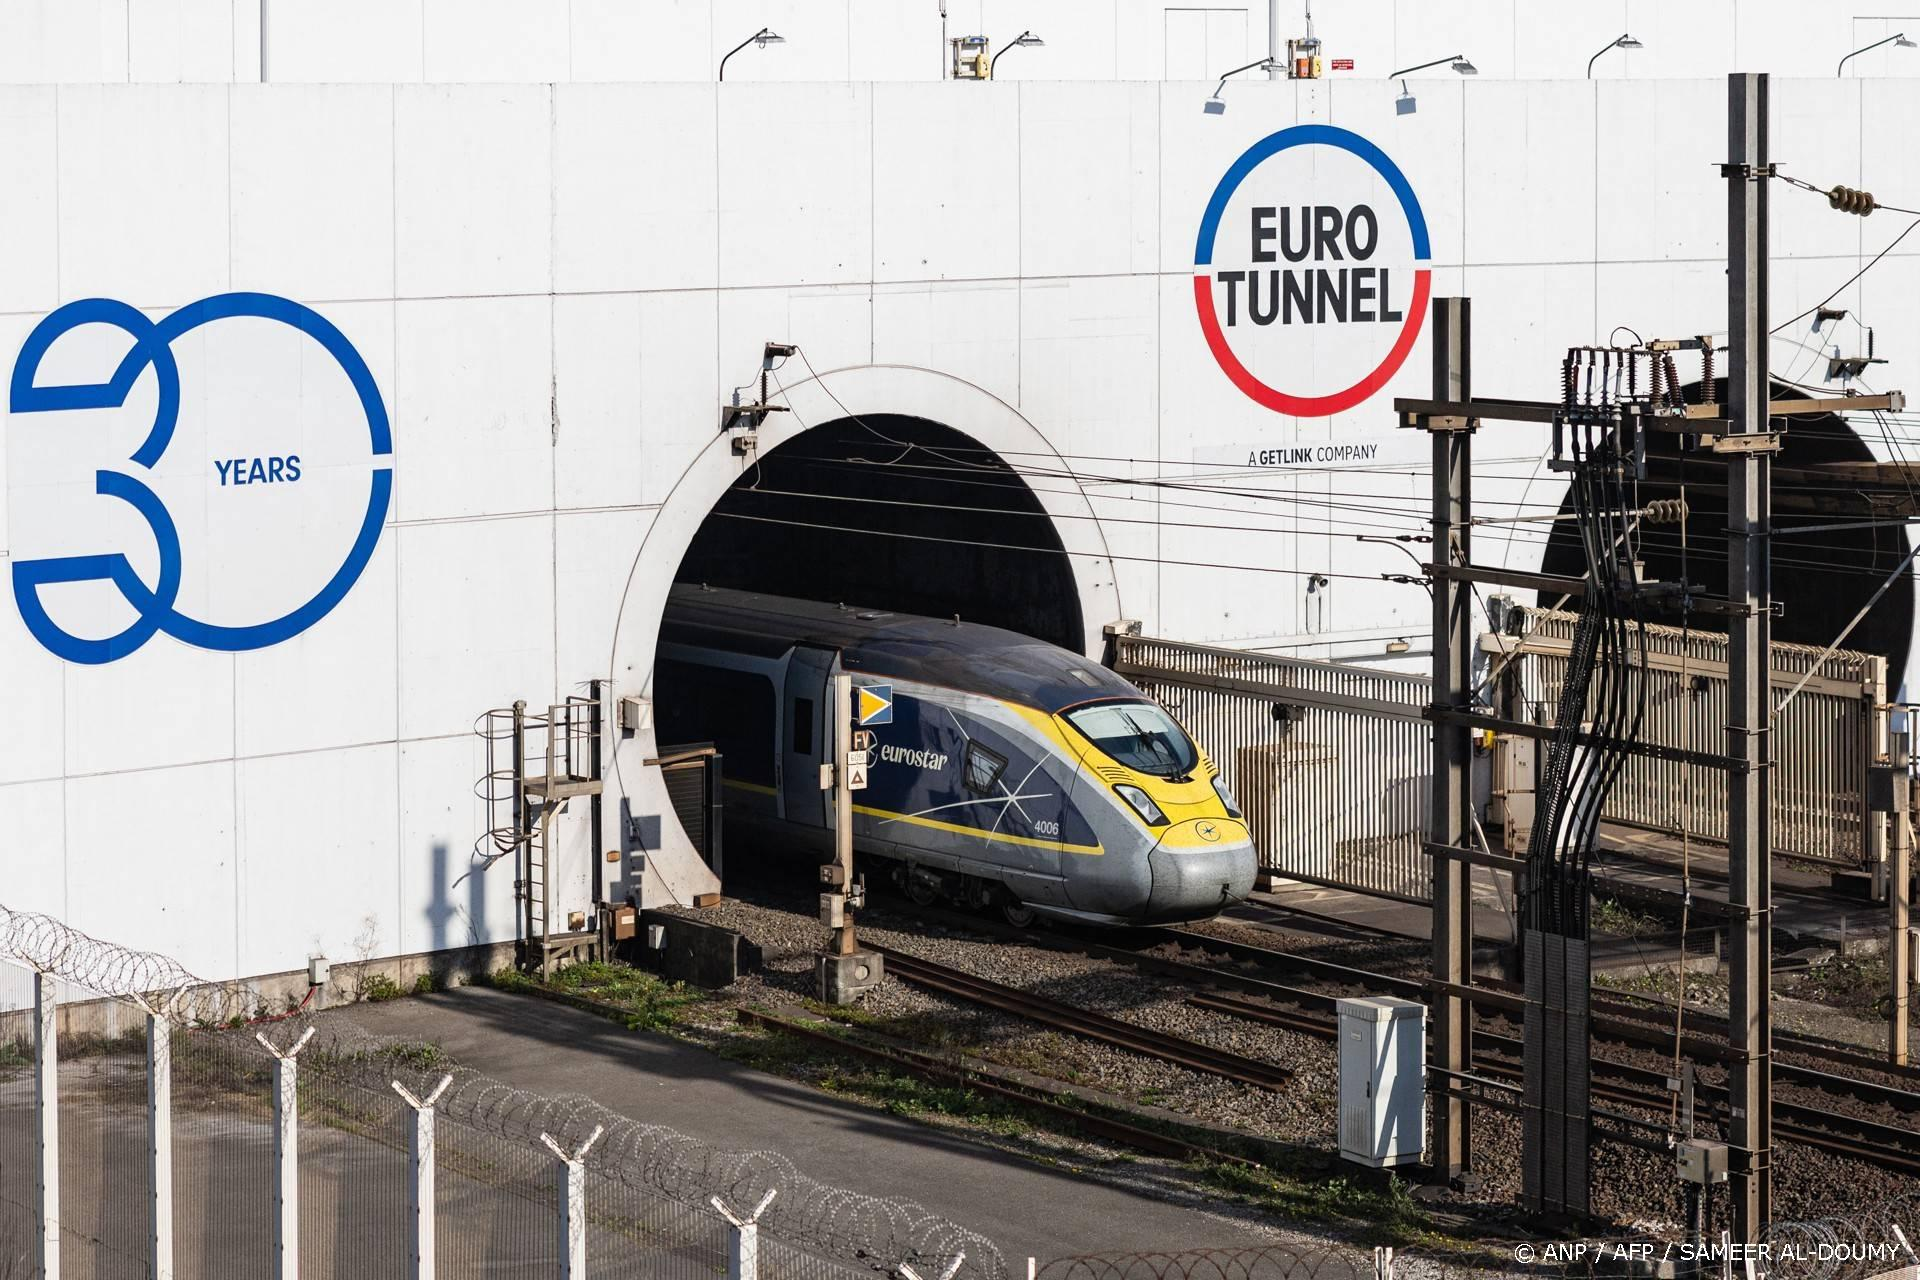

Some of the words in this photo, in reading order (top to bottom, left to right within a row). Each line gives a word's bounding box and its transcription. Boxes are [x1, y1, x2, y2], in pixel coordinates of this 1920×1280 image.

[1251, 204, 1378, 262] EURO
[1217, 267, 1402, 326] TUNNEL
[1248, 451, 1257, 466] A
[1260, 448, 1312, 465] GETLINK
[1317, 444, 1377, 462] COMPANY
[9, 292, 392, 665] 30
[214, 455, 301, 486] YEARS
[854, 731, 870, 750] FV
[881, 744, 948, 771] eurostar
[1034, 820, 1059, 836] 4006
